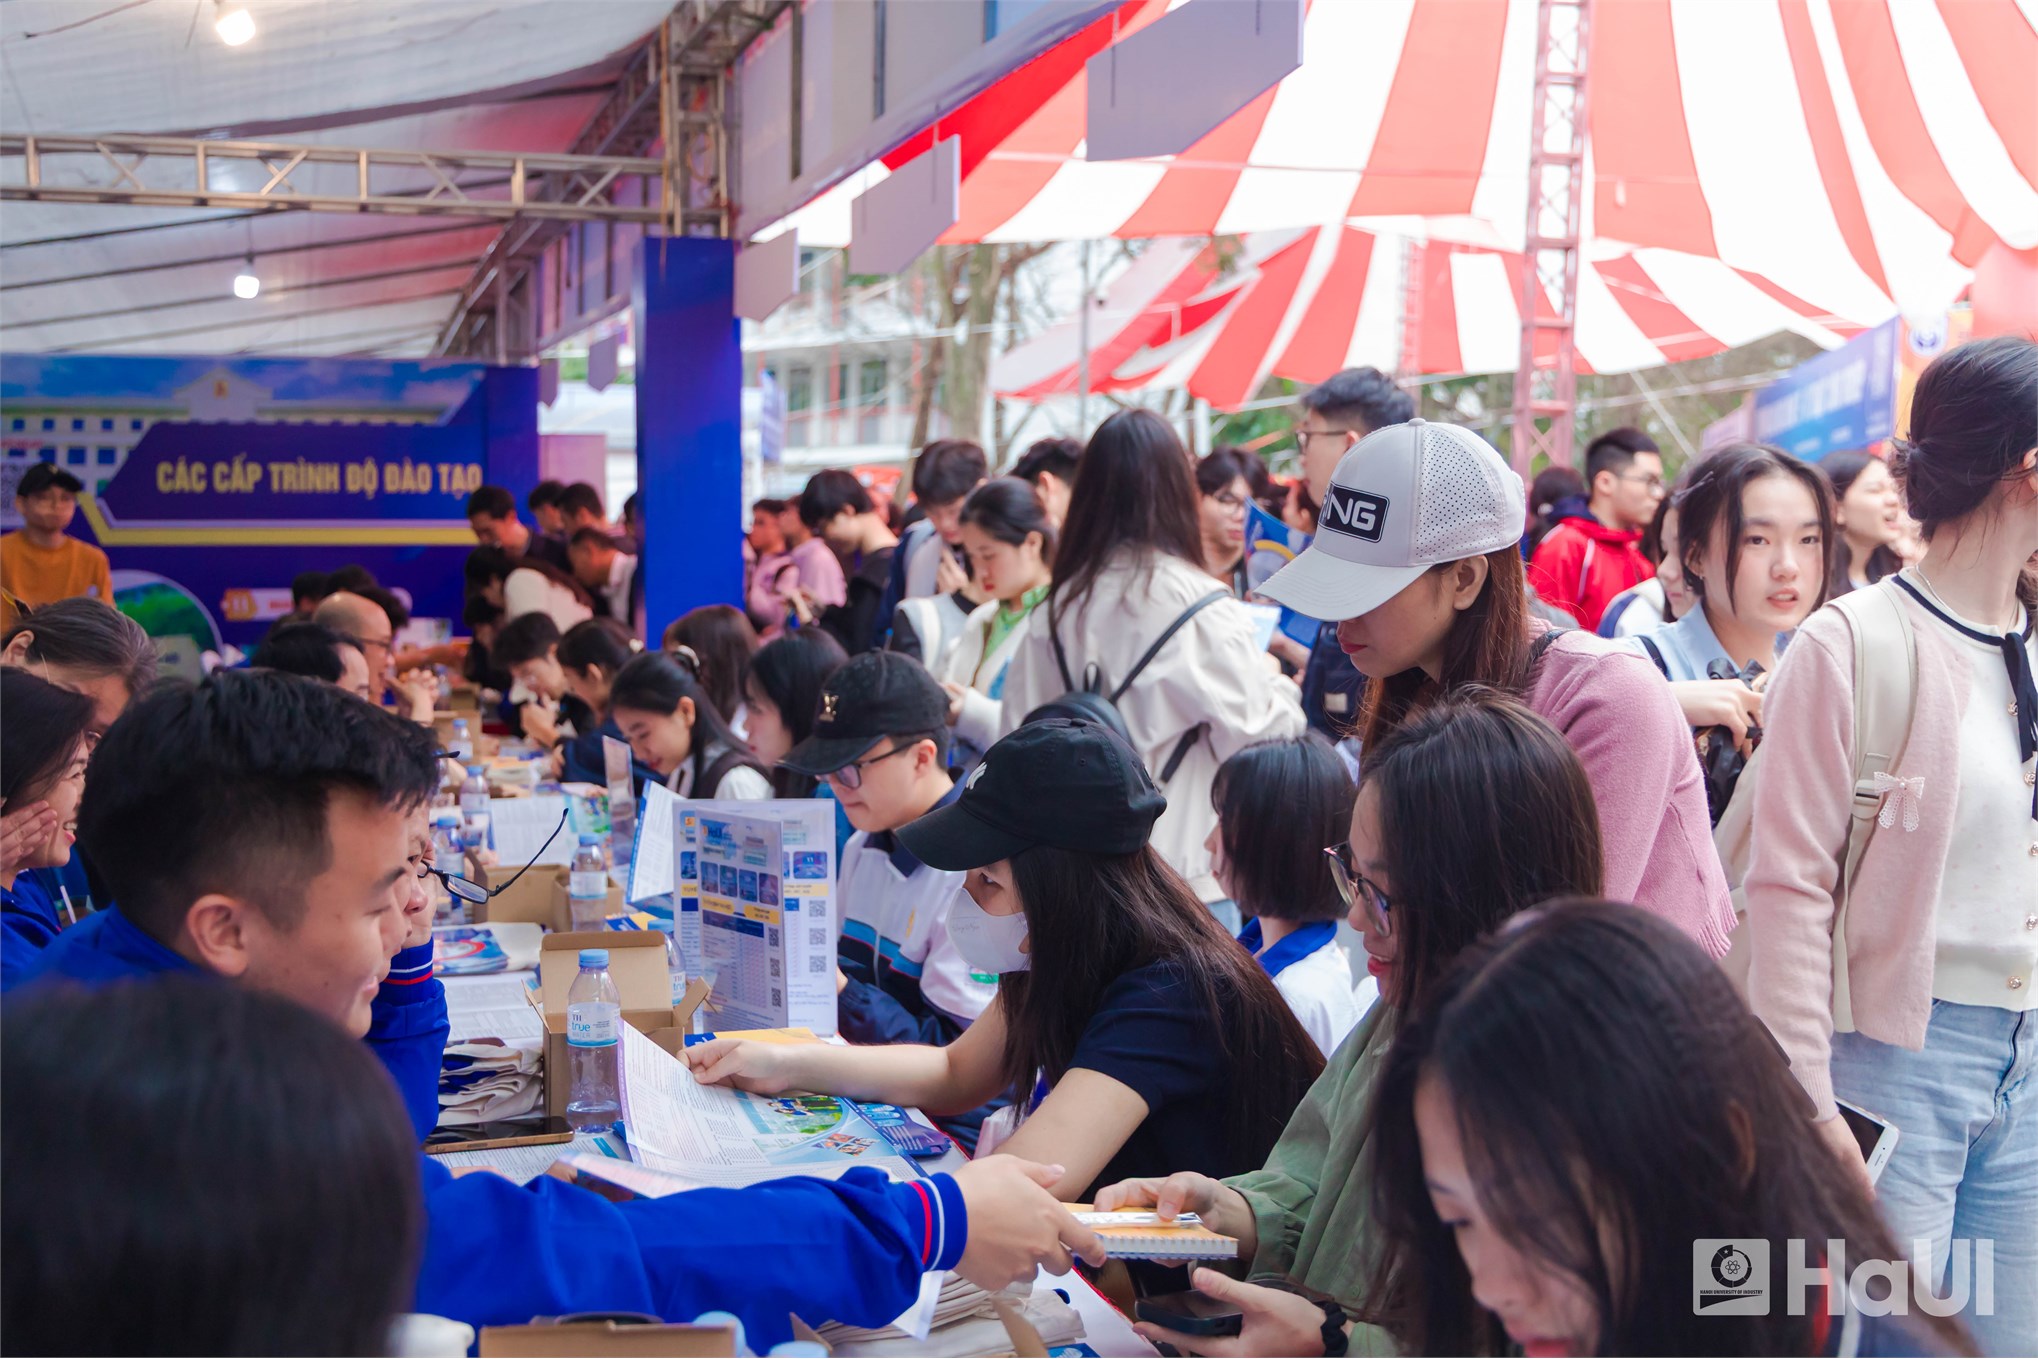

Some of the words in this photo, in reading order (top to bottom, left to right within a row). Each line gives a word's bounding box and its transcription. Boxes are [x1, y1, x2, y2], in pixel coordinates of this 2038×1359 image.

[156, 456, 207, 494] CÁC
[213, 452, 263, 494] CẤP
[268, 455, 341, 494] TRÌNH
[345, 456, 379, 500] ĐỘ
[384, 456, 433, 494] ĐÀO
[437, 463, 483, 500] TẠO
[571, 1021, 591, 1032] true
